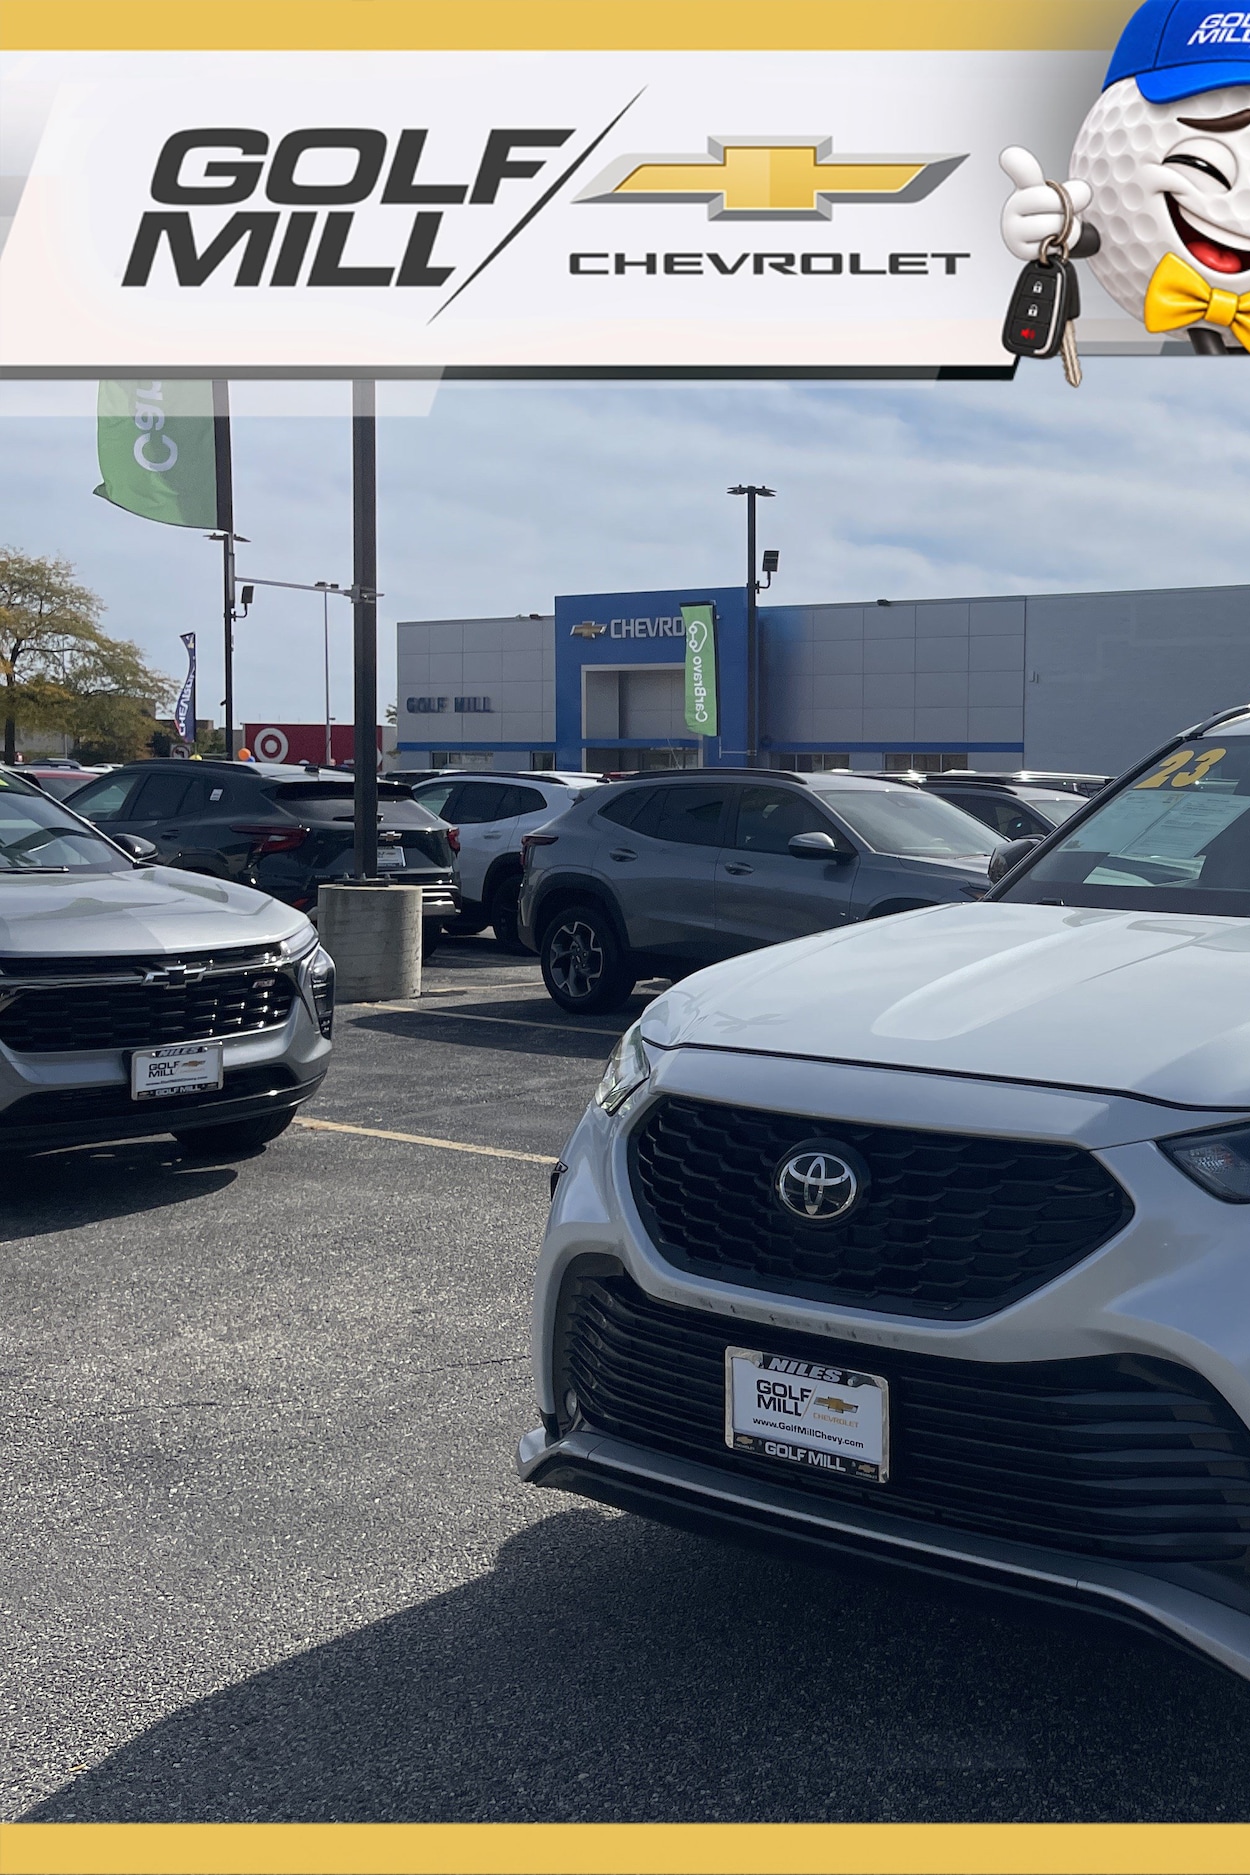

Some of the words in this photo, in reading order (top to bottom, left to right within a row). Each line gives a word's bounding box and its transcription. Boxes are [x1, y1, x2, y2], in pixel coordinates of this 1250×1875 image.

[610, 616, 686, 638] CHEVRO
[406, 697, 449, 714] GOLF
[454, 696, 495, 713] MILL
[1133, 748, 1226, 789] 23
[148, 1060, 180, 1071] GOLF
[148, 1069, 175, 1078] MILL
[768, 1357, 842, 1383] NILES
[756, 1379, 812, 1402] GOLF
[757, 1394, 802, 1417] MILL
[812, 1412, 859, 1428] CHEVROLET
[752, 1417, 865, 1449] www.GolfMillChevy.com
[764, 1441, 806, 1461] GOLF
[807, 1448, 847, 1472] MILL
